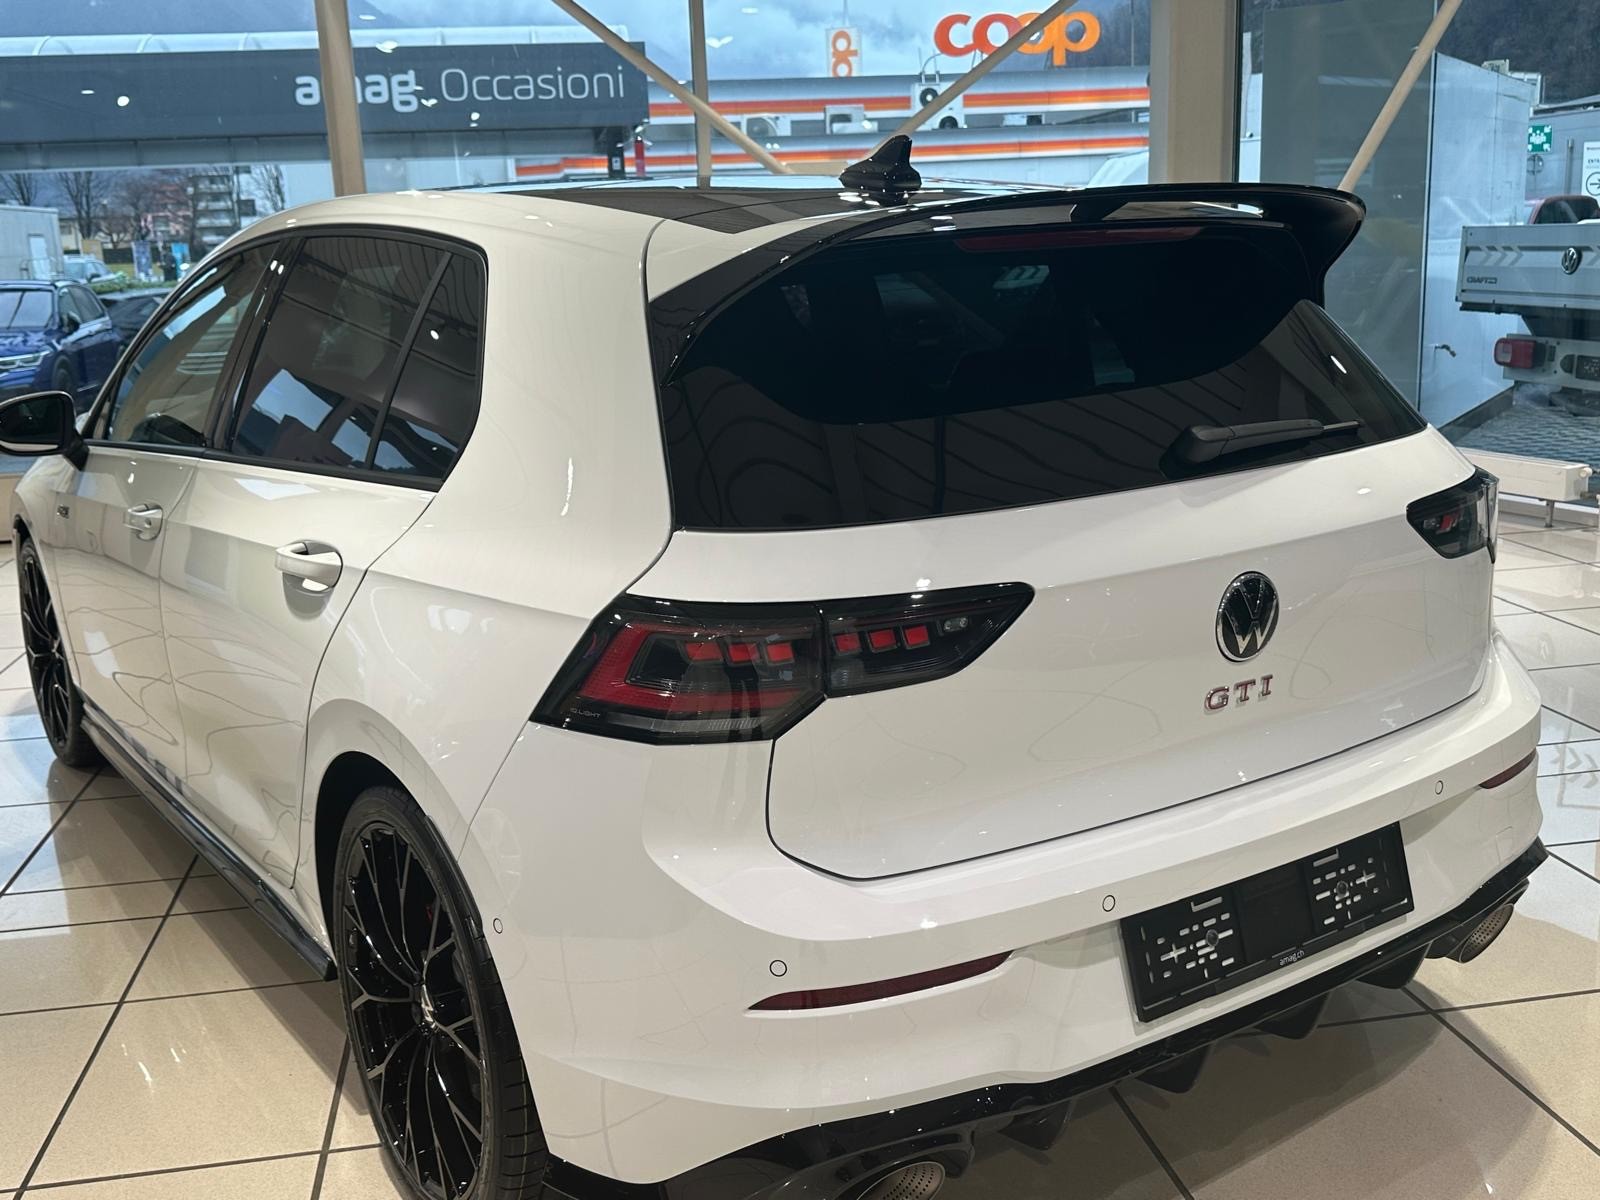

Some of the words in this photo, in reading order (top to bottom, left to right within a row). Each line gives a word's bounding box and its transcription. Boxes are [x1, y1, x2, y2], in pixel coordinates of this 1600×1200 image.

[933, 11, 1101, 66] coop
[294, 69, 418, 113] aag
[441, 65, 625, 101] Occasioni
[1204, 674, 1273, 711] GTI
[1279, 950, 1305, 966] amag.ch
